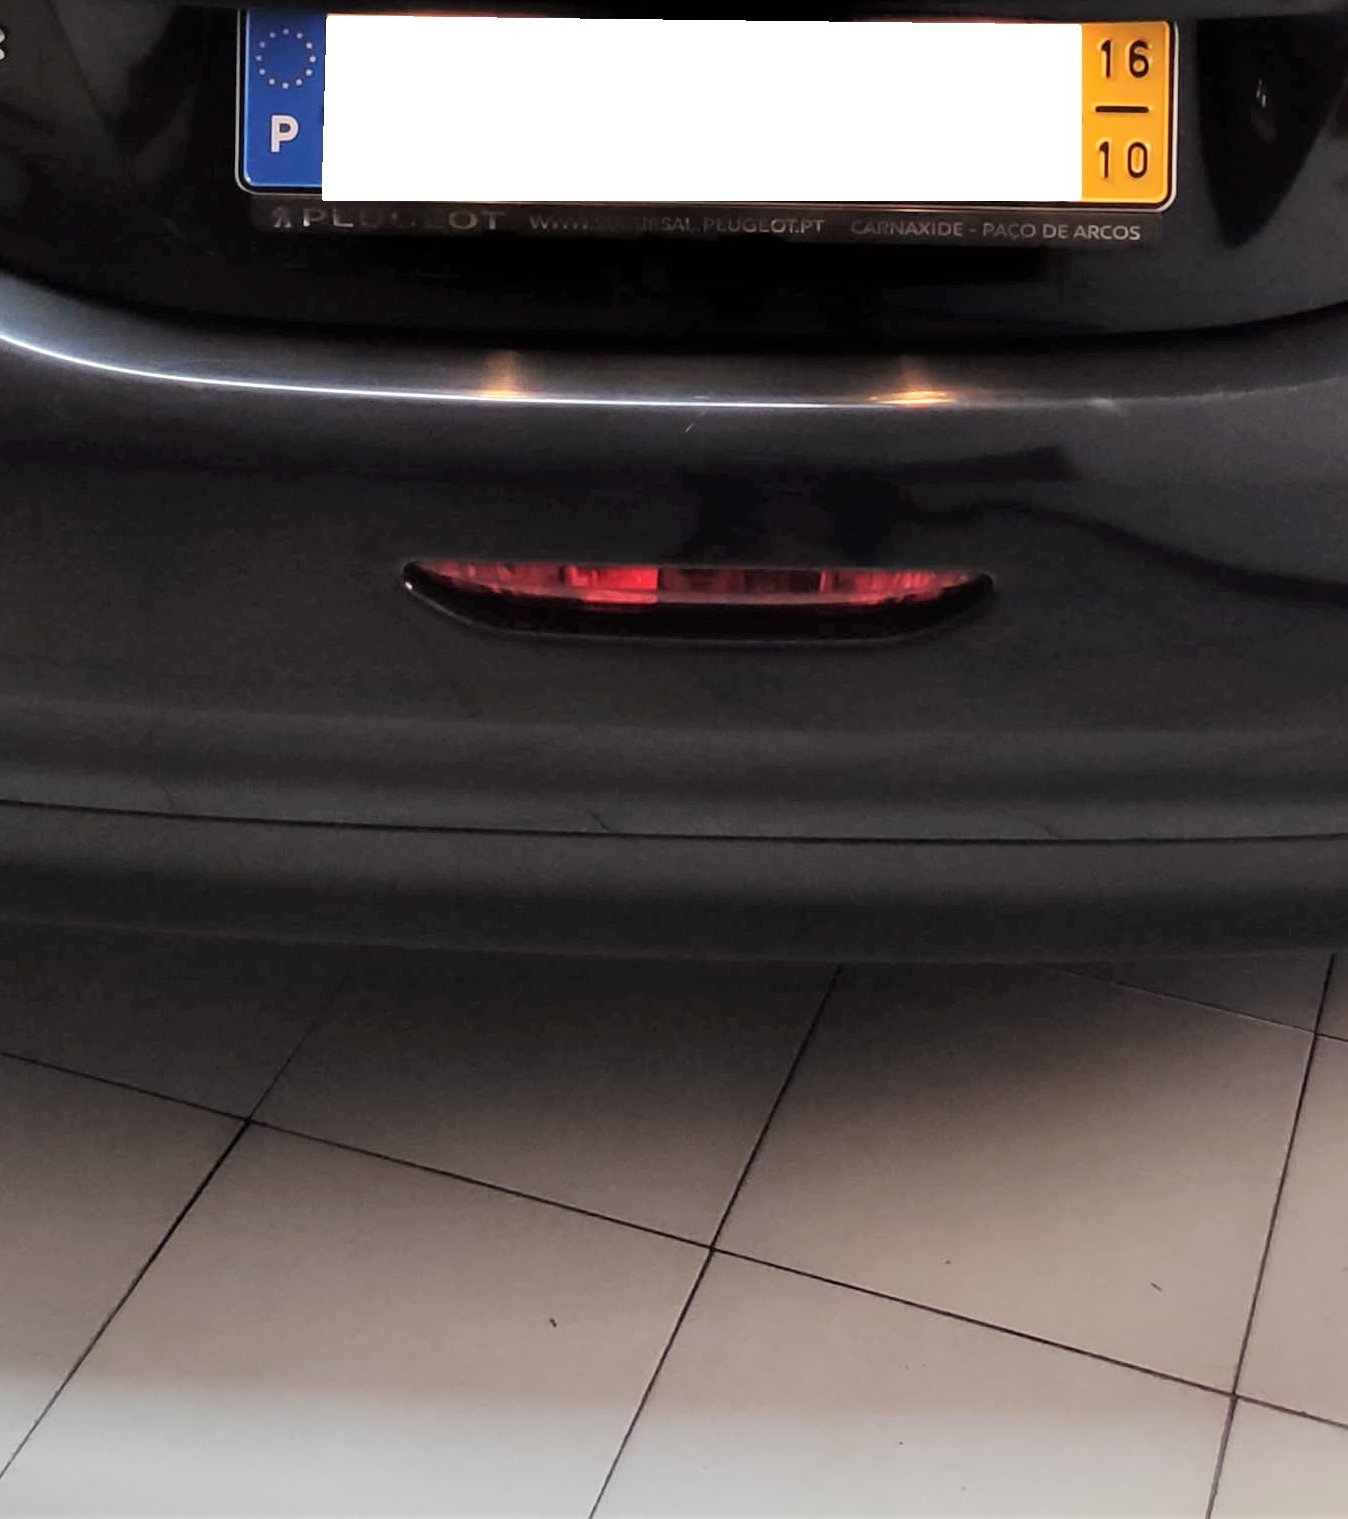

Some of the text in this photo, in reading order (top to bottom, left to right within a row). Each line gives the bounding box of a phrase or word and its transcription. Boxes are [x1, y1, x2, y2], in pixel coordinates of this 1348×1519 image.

[1100, 39, 1150, 79] 16
[270, 114, 300, 153] P
[1098, 140, 1149, 179] 10
[302, 208, 507, 230] PEUOT
[850, 219, 964, 237] CARNAXIDE
[982, 221, 1037, 241] PAÇO
[1042, 223, 1069, 240] DE
[1073, 224, 1142, 242] ARCOS
